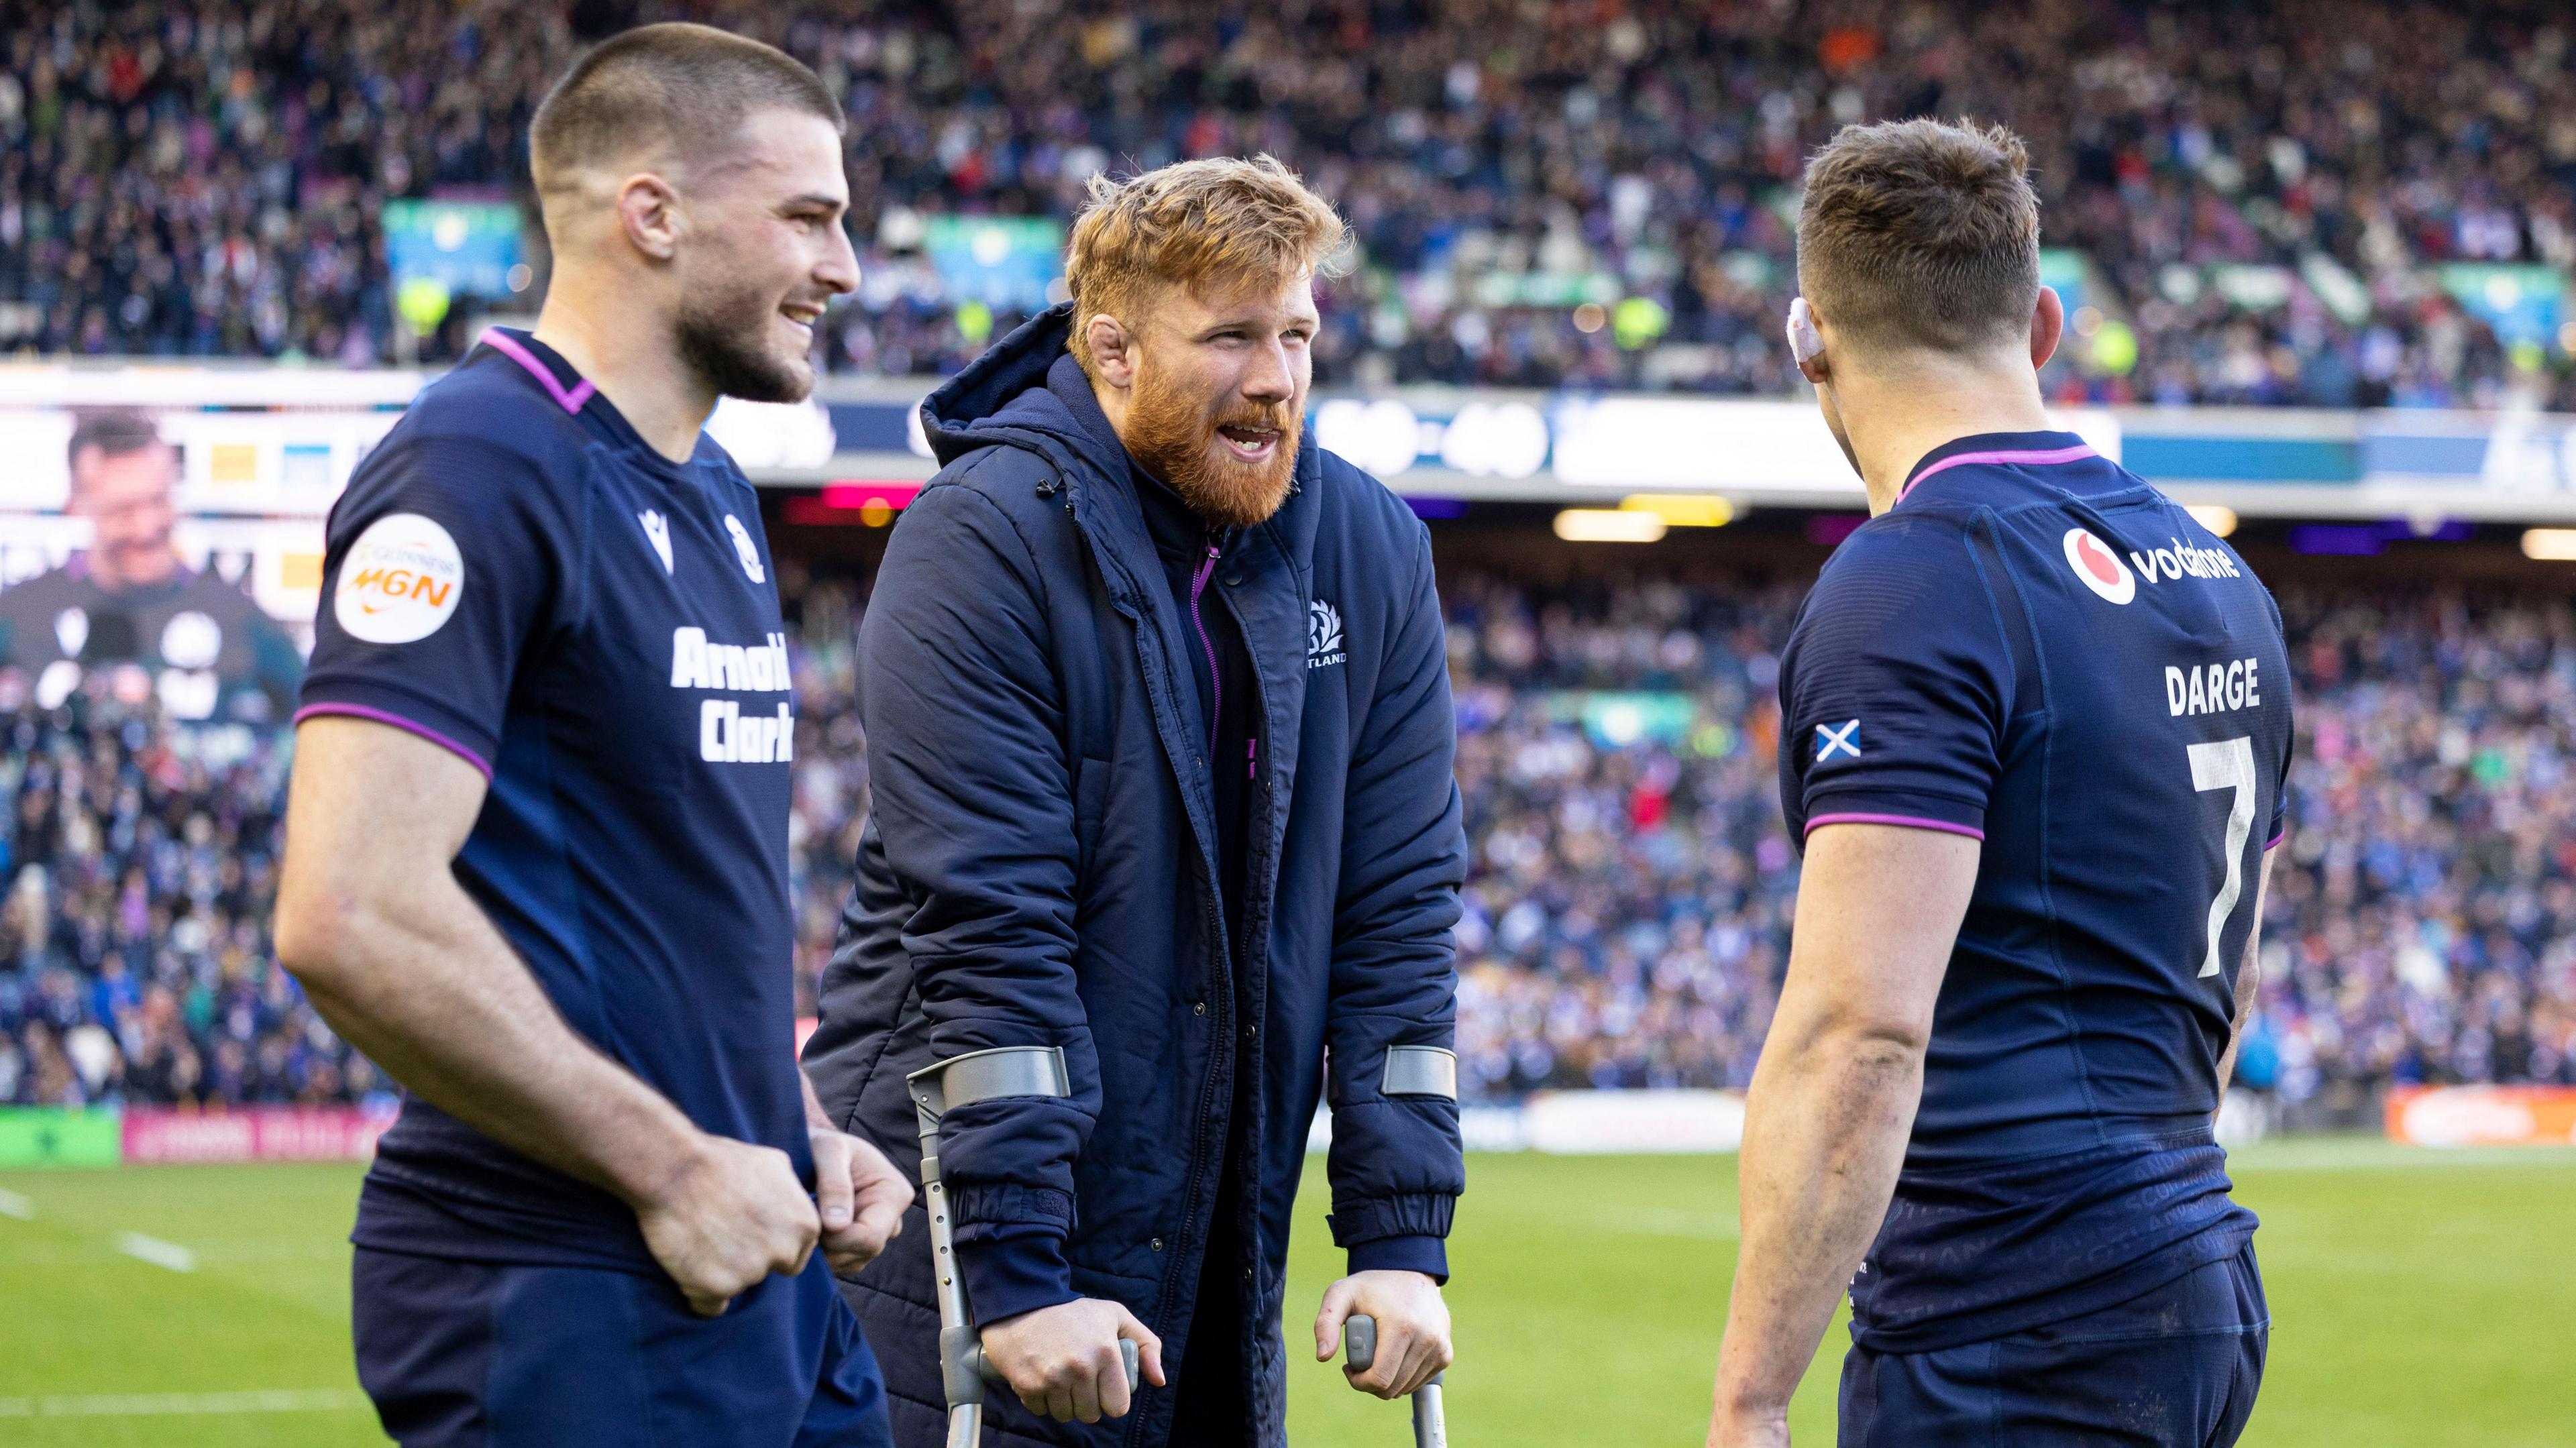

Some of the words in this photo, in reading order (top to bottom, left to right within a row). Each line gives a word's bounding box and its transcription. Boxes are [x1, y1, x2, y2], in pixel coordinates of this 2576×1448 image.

[1308, 653, 1346, 669] TLAND
[2165, 657, 2260, 716] DARGE
[700, 699, 794, 763] Clark
[2186, 735, 2256, 979] 7
